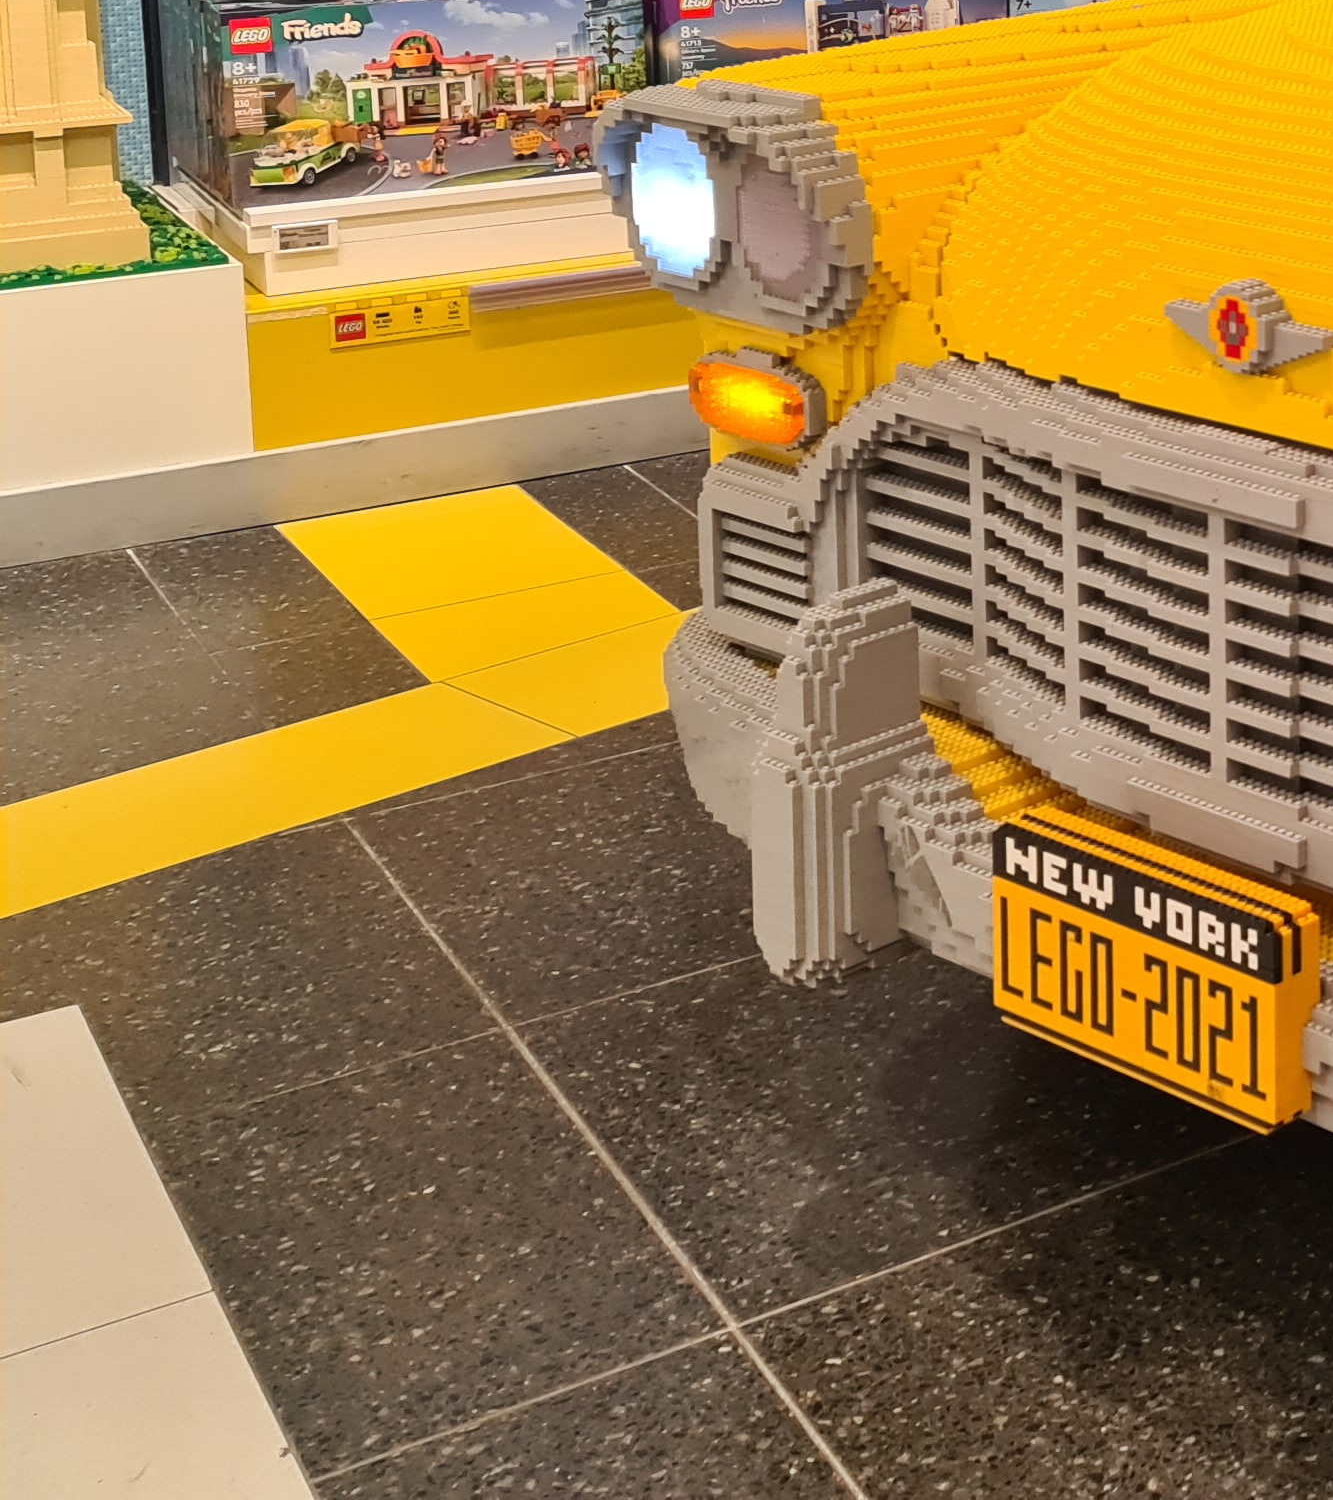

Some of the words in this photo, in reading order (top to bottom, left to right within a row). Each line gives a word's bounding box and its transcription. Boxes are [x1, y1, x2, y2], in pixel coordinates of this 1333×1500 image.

[1016, 0, 1032, 11] 7+
[231, 26, 270, 44] LEGO
[280, 12, 363, 41] Friends
[680, 25, 701, 38] 8+
[232, 61, 257, 76] 8+
[233, 76, 260, 85] 41729
[338, 321, 363, 334] LEGO
[1005, 836, 1114, 912] NEW
[1134, 885, 1260, 971] YORK
[1000, 894, 1268, 1102] LEGO-2021
